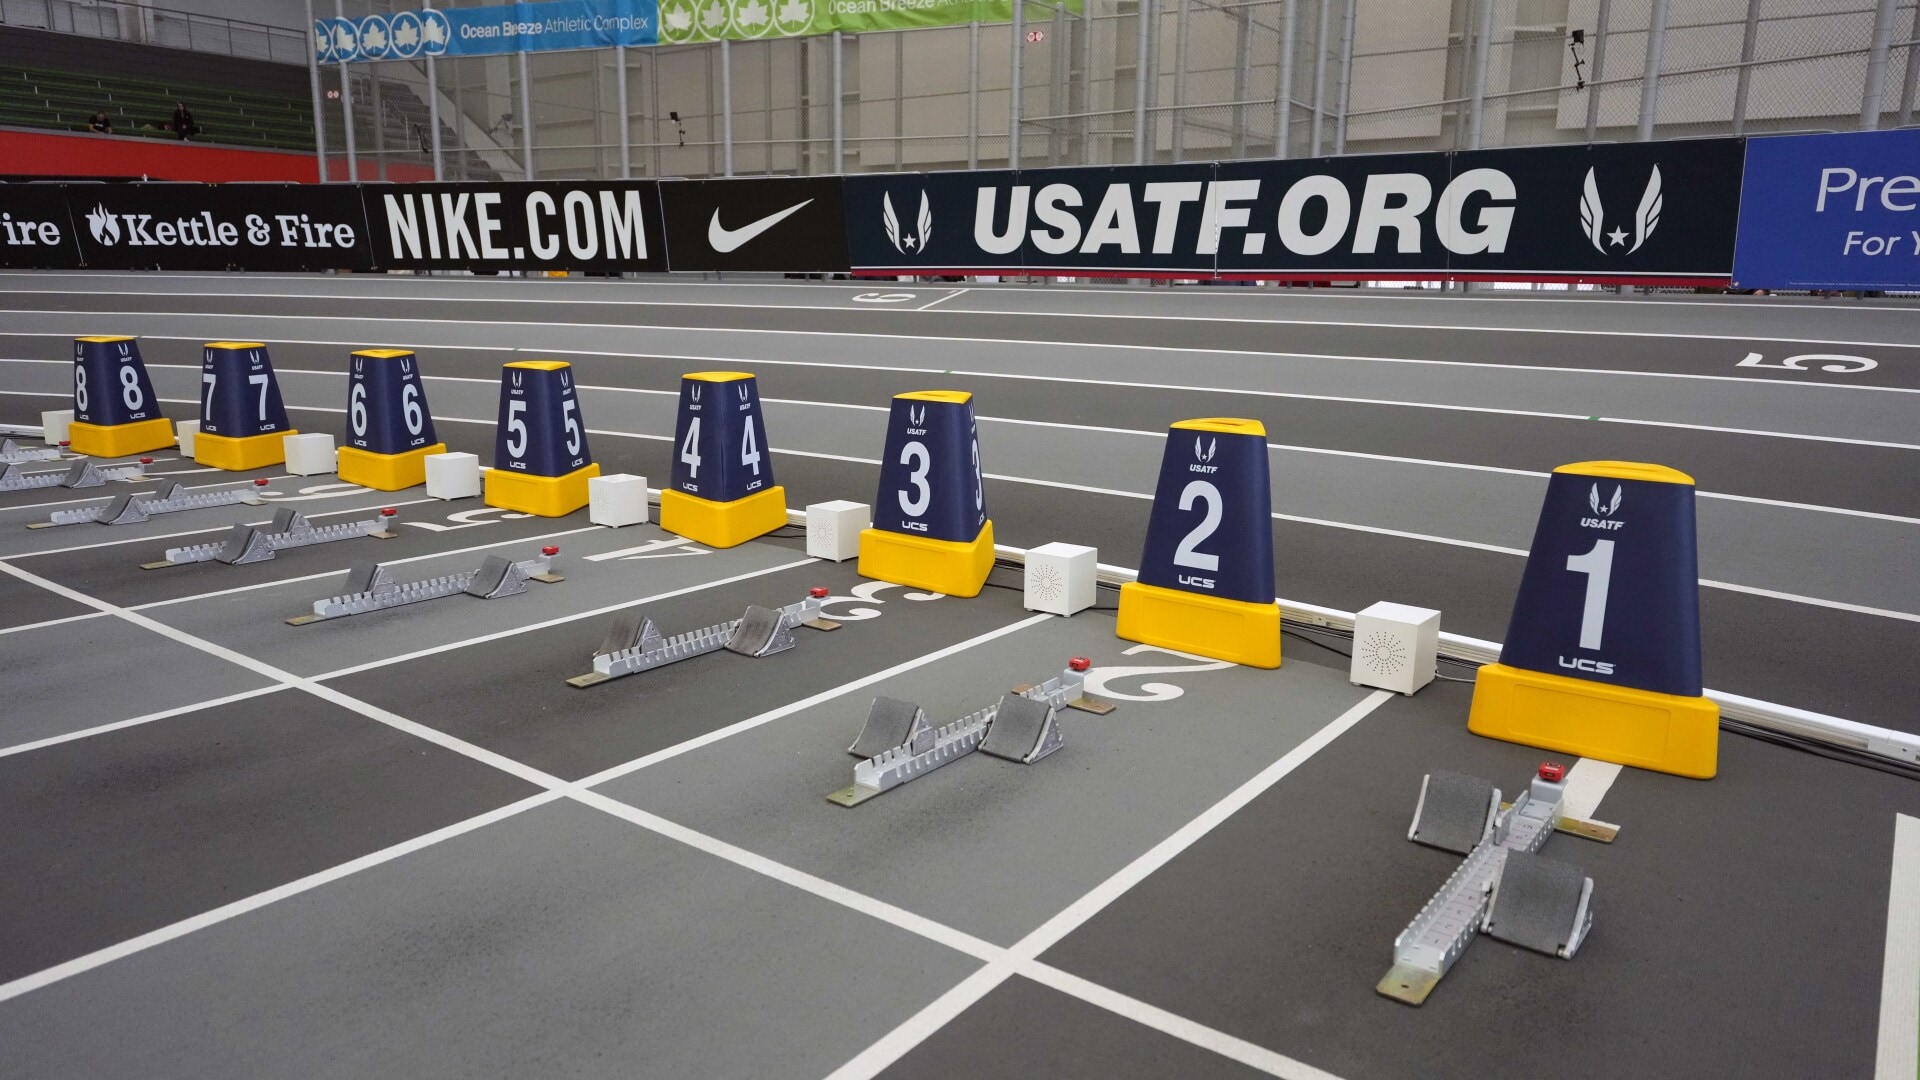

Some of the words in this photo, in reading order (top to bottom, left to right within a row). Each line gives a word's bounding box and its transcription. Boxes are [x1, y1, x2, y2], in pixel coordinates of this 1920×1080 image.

[460, 24, 500, 39] Ocean
[544, 15, 591, 33] Athletic
[593, 15, 649, 33] Complex
[974, 168, 1517, 255] USATF.ORG
[1816, 167, 1920, 212] Pre
[0, 212, 61, 246] ire
[122, 211, 239, 247] Kettle
[245, 213, 271, 247] &
[275, 213, 355, 248] Fire
[383, 190, 648, 260] NIKE.COM
[1843, 231, 1902, 256] For
[1735, 352, 1878, 373] 5
[75, 365, 88, 412] 8
[120, 365, 143, 411] 8
[203, 373, 216, 420] 7
[249, 374, 268, 421] 7
[351, 382, 367, 437] 6
[402, 383, 423, 436] 6
[260, 423, 276, 431] UCS
[410, 437, 425, 446] UCS
[506, 400, 528, 458] 5
[562, 399, 581, 456] 5
[681, 416, 701, 479] 4
[741, 415, 761, 476] 4
[907, 427, 928, 436] USATF
[509, 461, 526, 470] UCS
[571, 457, 583, 467] UCS
[898, 441, 931, 517] 3
[971, 438, 983, 511] 3
[1189, 463, 1217, 474] USATF
[682, 481, 698, 492] UCS
[746, 480, 762, 490] UCS
[902, 520, 928, 531] UCS
[1173, 480, 1223, 572] 2
[1580, 517, 1624, 531] USATF
[1178, 574, 1215, 589] UCS
[1566, 539, 1615, 651] 1
[1083, 643, 1239, 702] 2
[1558, 655, 1615, 675] UCS
